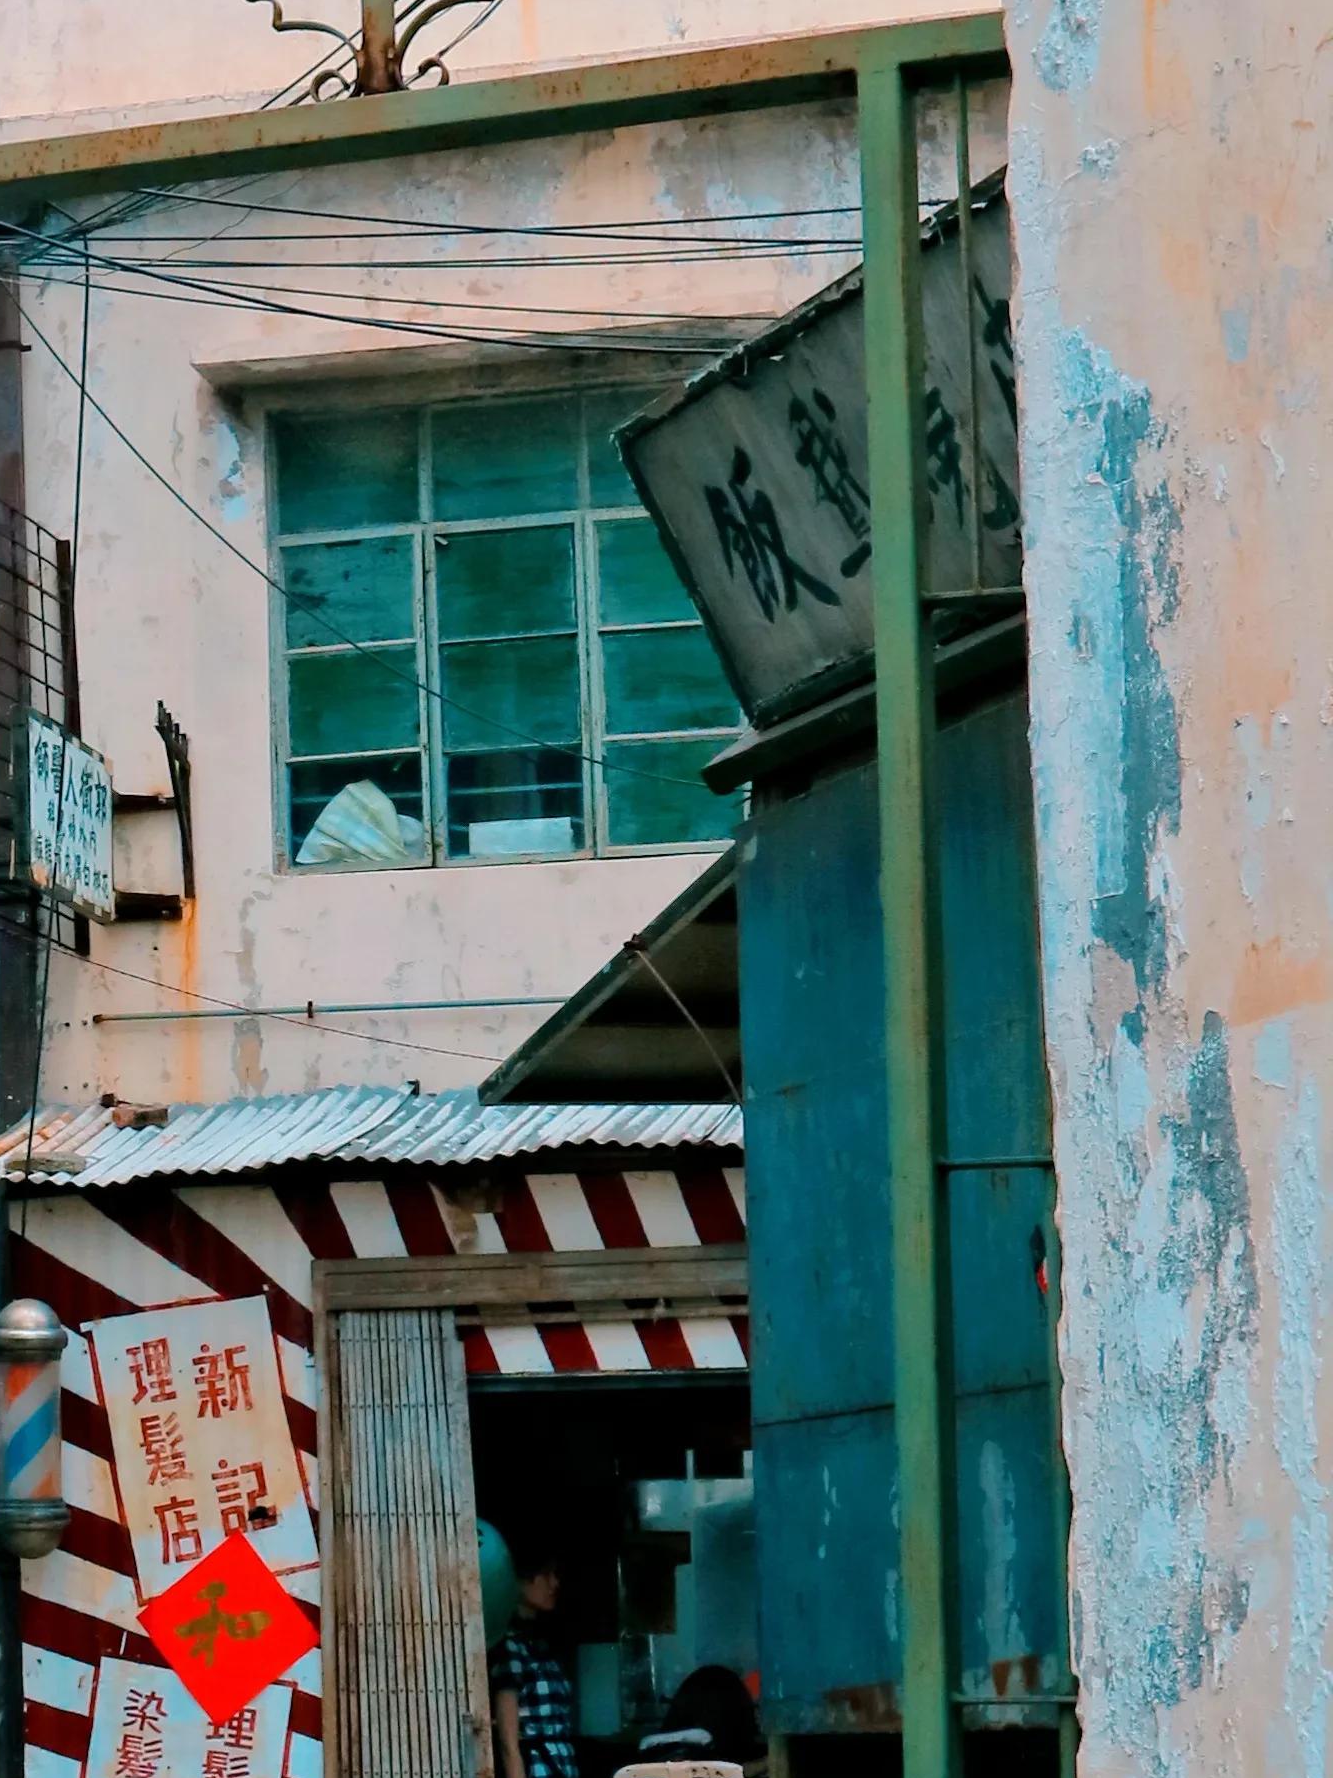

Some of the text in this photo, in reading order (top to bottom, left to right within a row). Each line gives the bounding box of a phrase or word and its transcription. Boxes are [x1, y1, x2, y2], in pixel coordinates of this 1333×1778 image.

[125, 1337, 204, 1565] 理髮店
[191, 1342, 278, 1536] 新記
